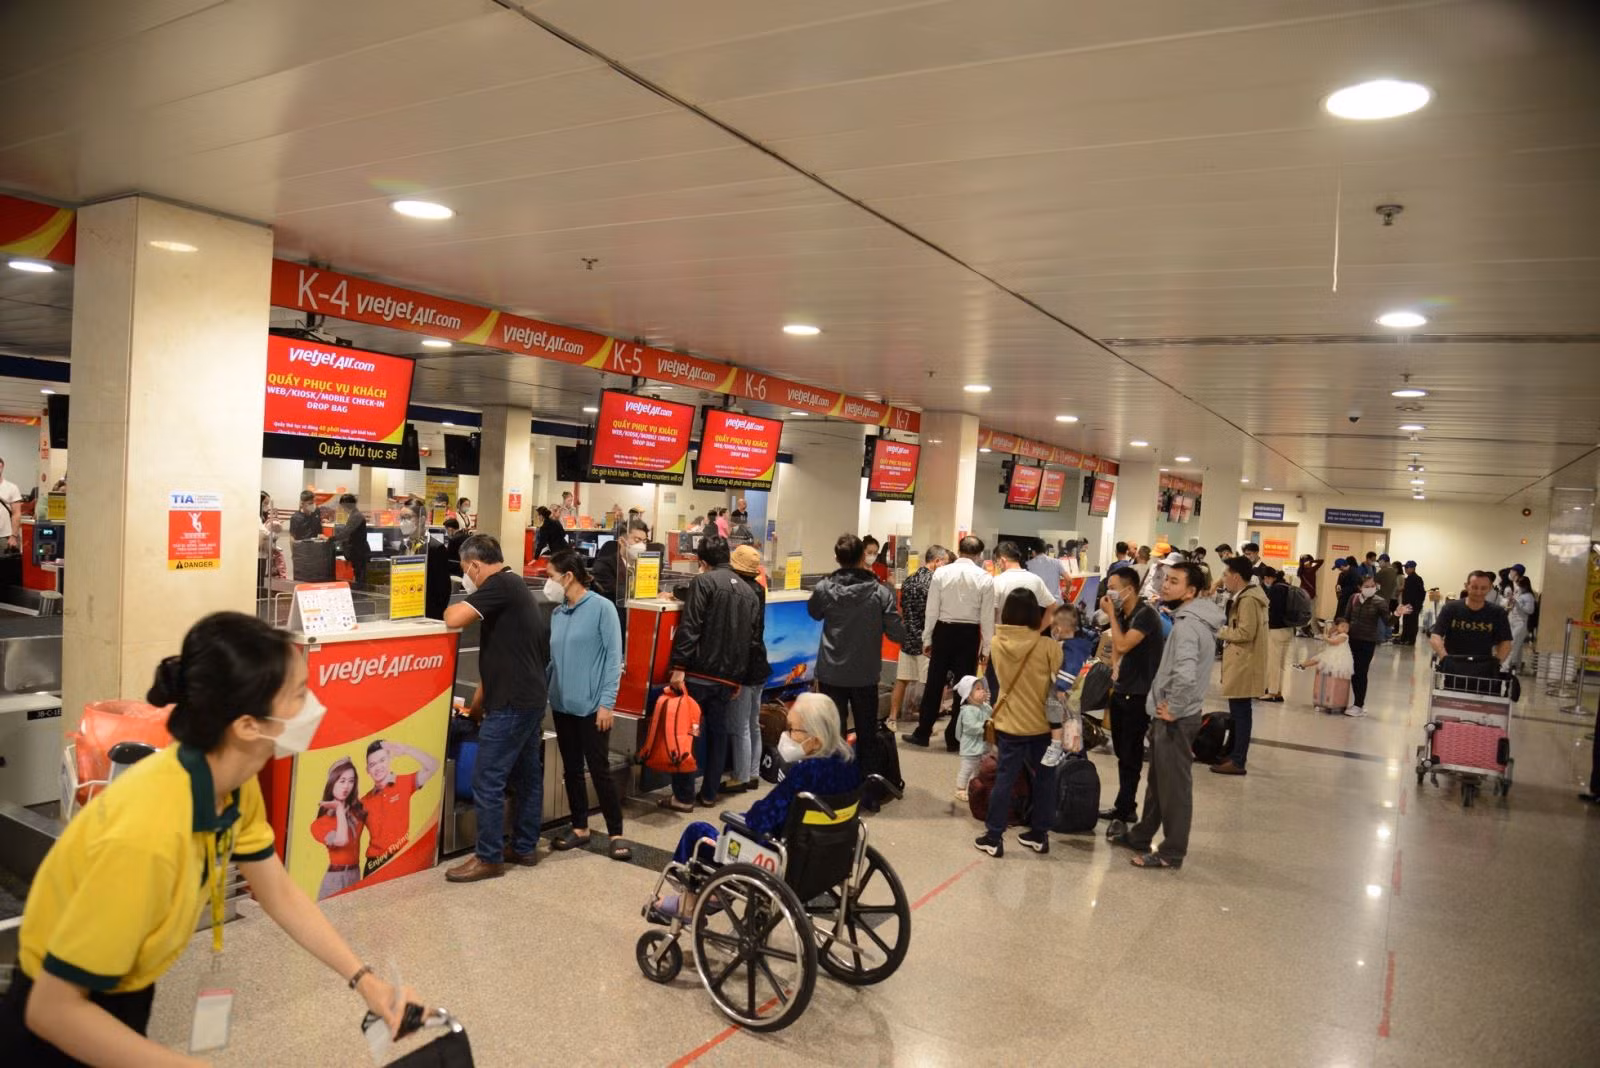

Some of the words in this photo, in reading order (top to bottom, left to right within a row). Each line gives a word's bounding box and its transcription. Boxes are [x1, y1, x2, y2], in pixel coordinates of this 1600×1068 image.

[298, 269, 349, 315] K-4
[613, 342, 642, 374] K-5
[303, 378, 333, 393] PHỤC
[335, 383, 350, 396] VỤ
[352, 384, 387, 399] KHÁCH
[745, 372, 767, 400] K-6
[267, 385, 350, 405] WEB/KIOSK/MOBILE
[351, 397, 385, 409] CHECK-IN
[307, 401, 329, 411] DROP
[331, 404, 348, 413] BAG
[896, 409, 910, 430] K-7
[319, 441, 347, 458] Quầy
[349, 443, 365, 457] thủ
[368, 447, 384, 461] tục
[385, 448, 398, 460] sẽ
[171, 494, 194, 504] TIA
[183, 561, 213, 569] DANGER
[367, 850, 388, 870] Enjoy
[388, 832, 410, 854] Flying
